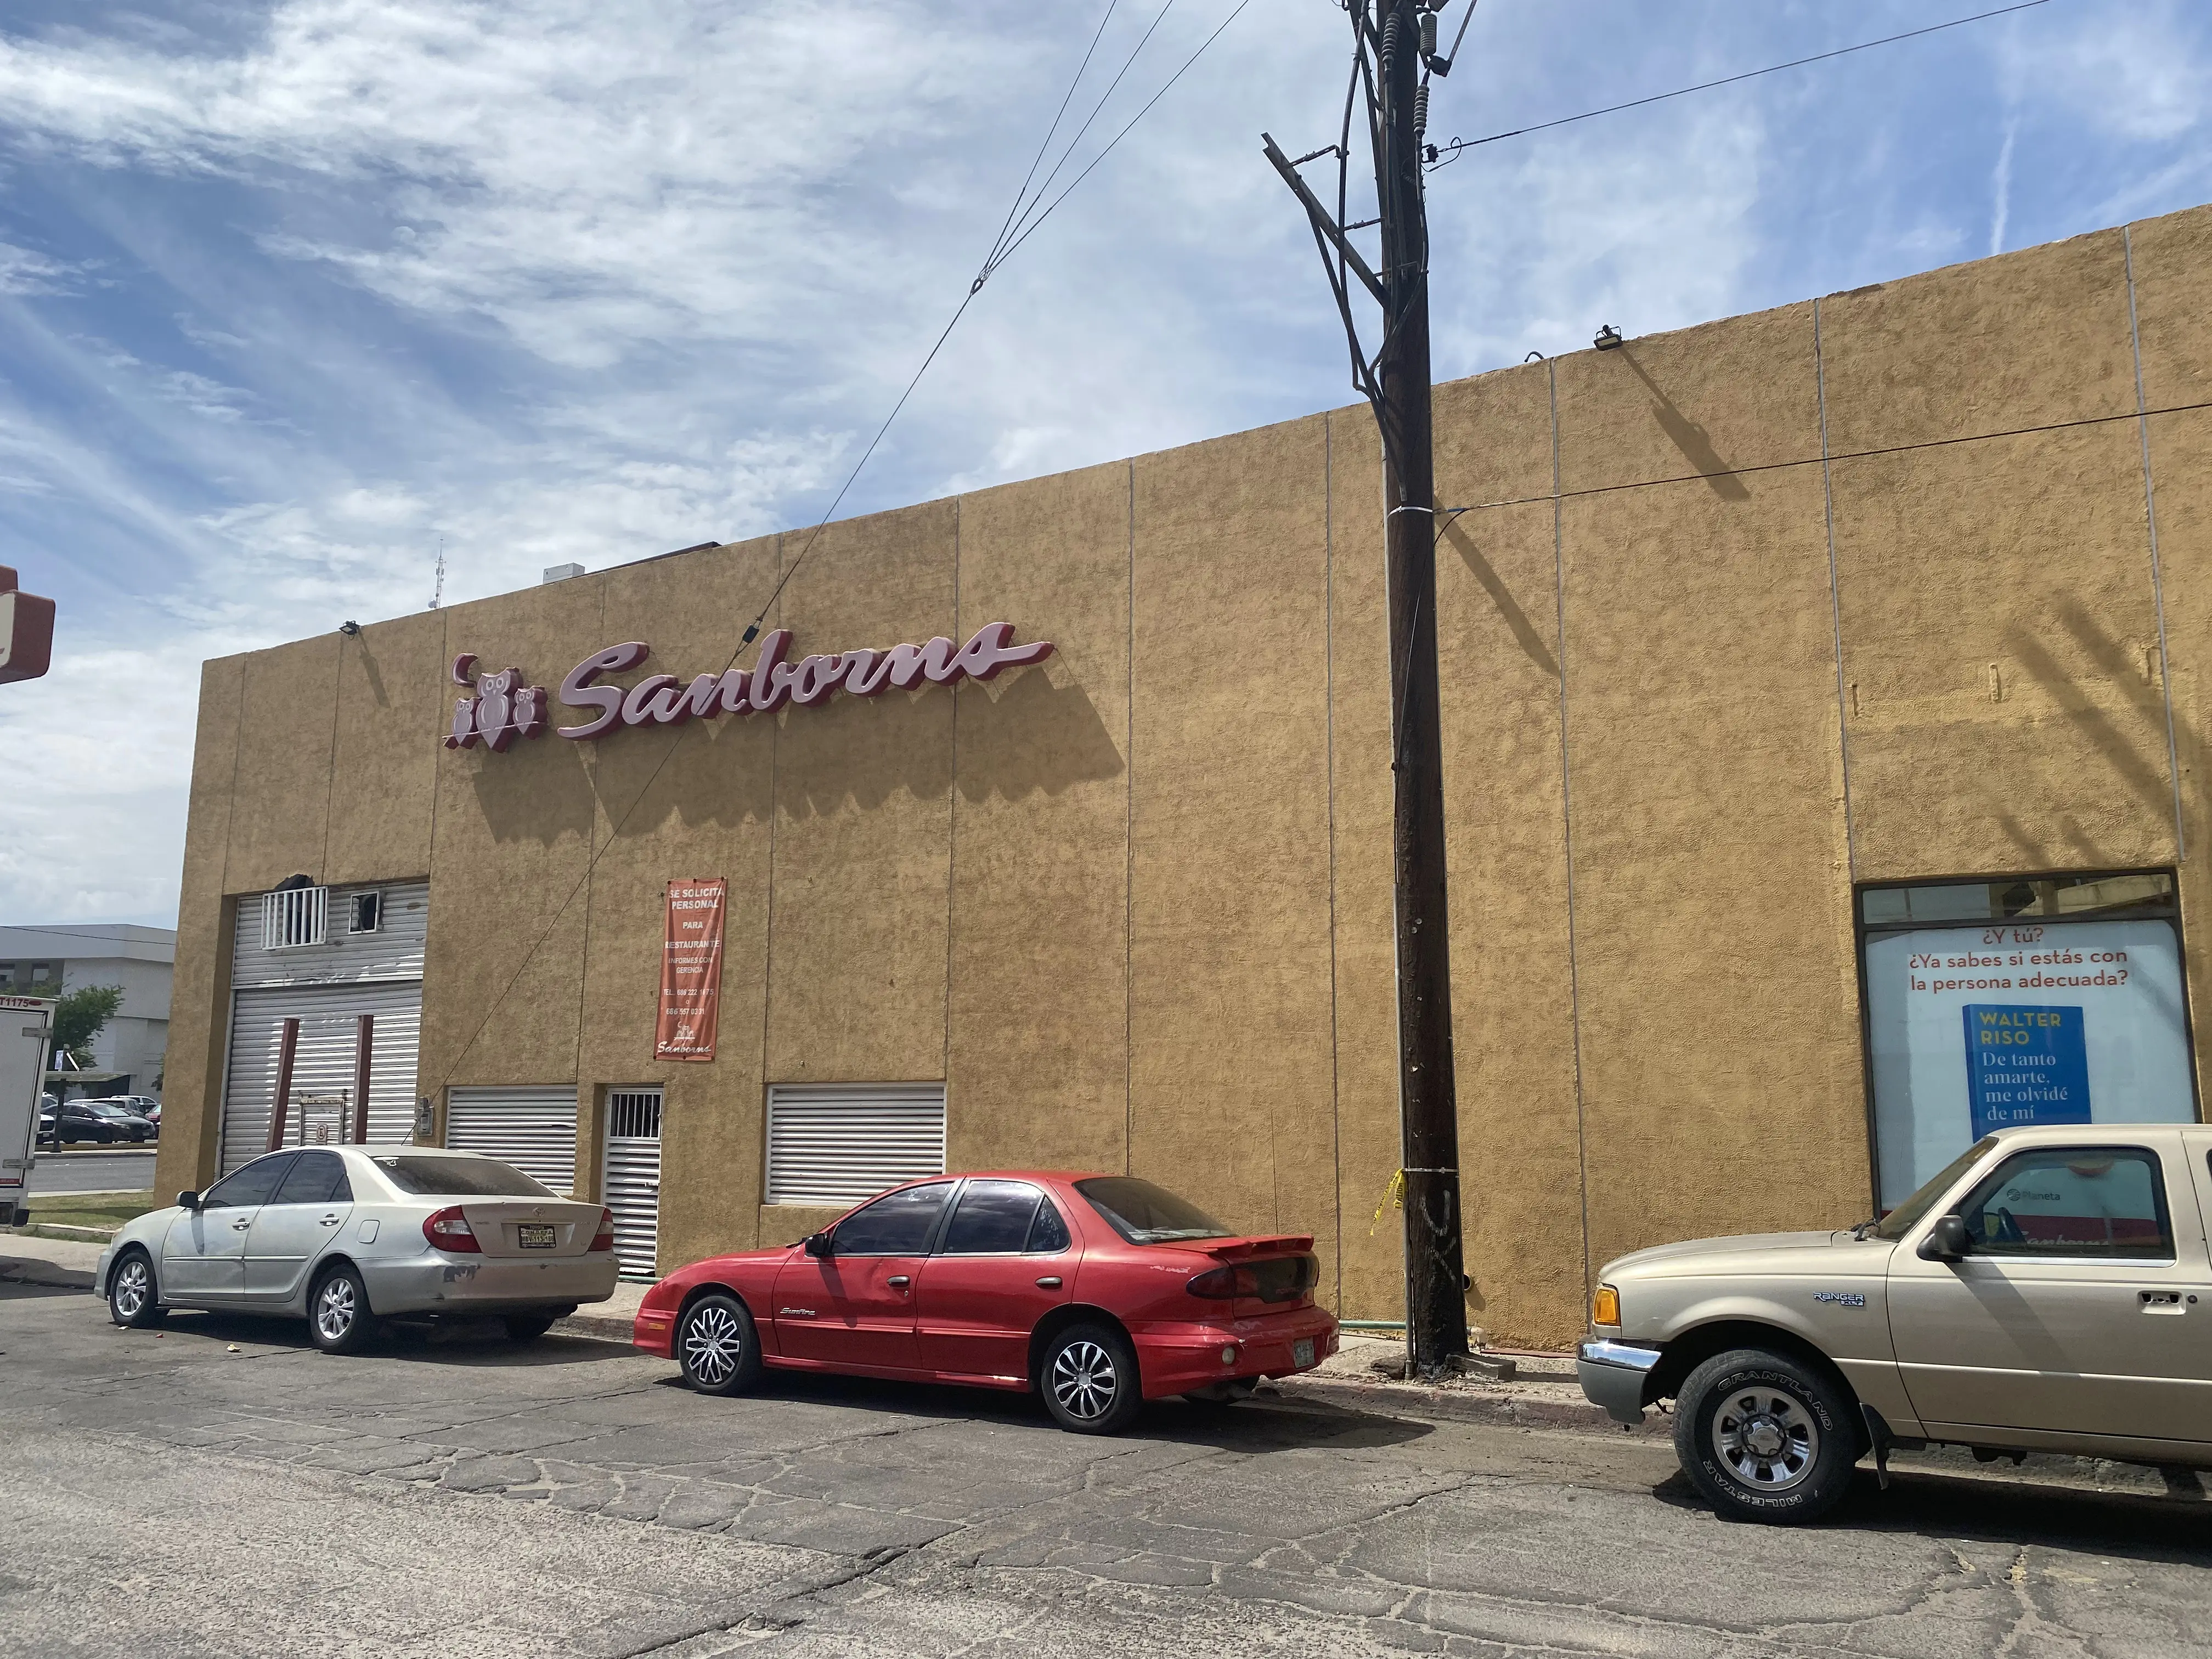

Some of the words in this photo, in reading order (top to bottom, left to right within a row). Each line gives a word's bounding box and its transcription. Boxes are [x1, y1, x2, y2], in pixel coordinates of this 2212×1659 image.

[557, 622, 1054, 741] Sanborns
[669, 889, 680, 898] SE
[682, 887, 724, 898] SOLICITA
[672, 900, 719, 910] PERSONAL
[682, 921, 703, 929] PARA
[1983, 928, 2006, 945] ¿Y
[2013, 927, 2044, 944] tú?
[664, 940, 720, 949] RESTAURANTE
[1909, 953, 1941, 969] ¿Ya
[1947, 952, 2002, 968] sabes
[2008, 951, 2024, 966] si
[2030, 948, 2083, 965] estás
[2090, 951, 2128, 963] con
[1910, 974, 1926, 991] la
[1933, 978, 2011, 994] persona
[2018, 969, 2129, 988] adecuada?
[1979, 1012, 2061, 1027] WALTER
[1981, 1030, 2029, 1045] RISO
[657, 1041, 712, 1053] Sanborns
[1983, 1052, 2006, 1066] De
[2012, 1053, 2056, 1066] tanto
[1984, 1071, 2050, 1085] amarte,
[1986, 1090, 2011, 1102] me
[2017, 1086, 2068, 1102] olvidé
[1987, 1105, 2007, 1121] de
[2013, 1105, 2035, 1120] mí
[780, 1307, 816, 1316] Sunfire
[1717, 1370, 1833, 1431] GRANTLAND
[1702, 1459, 1804, 1508] MILESTAR
